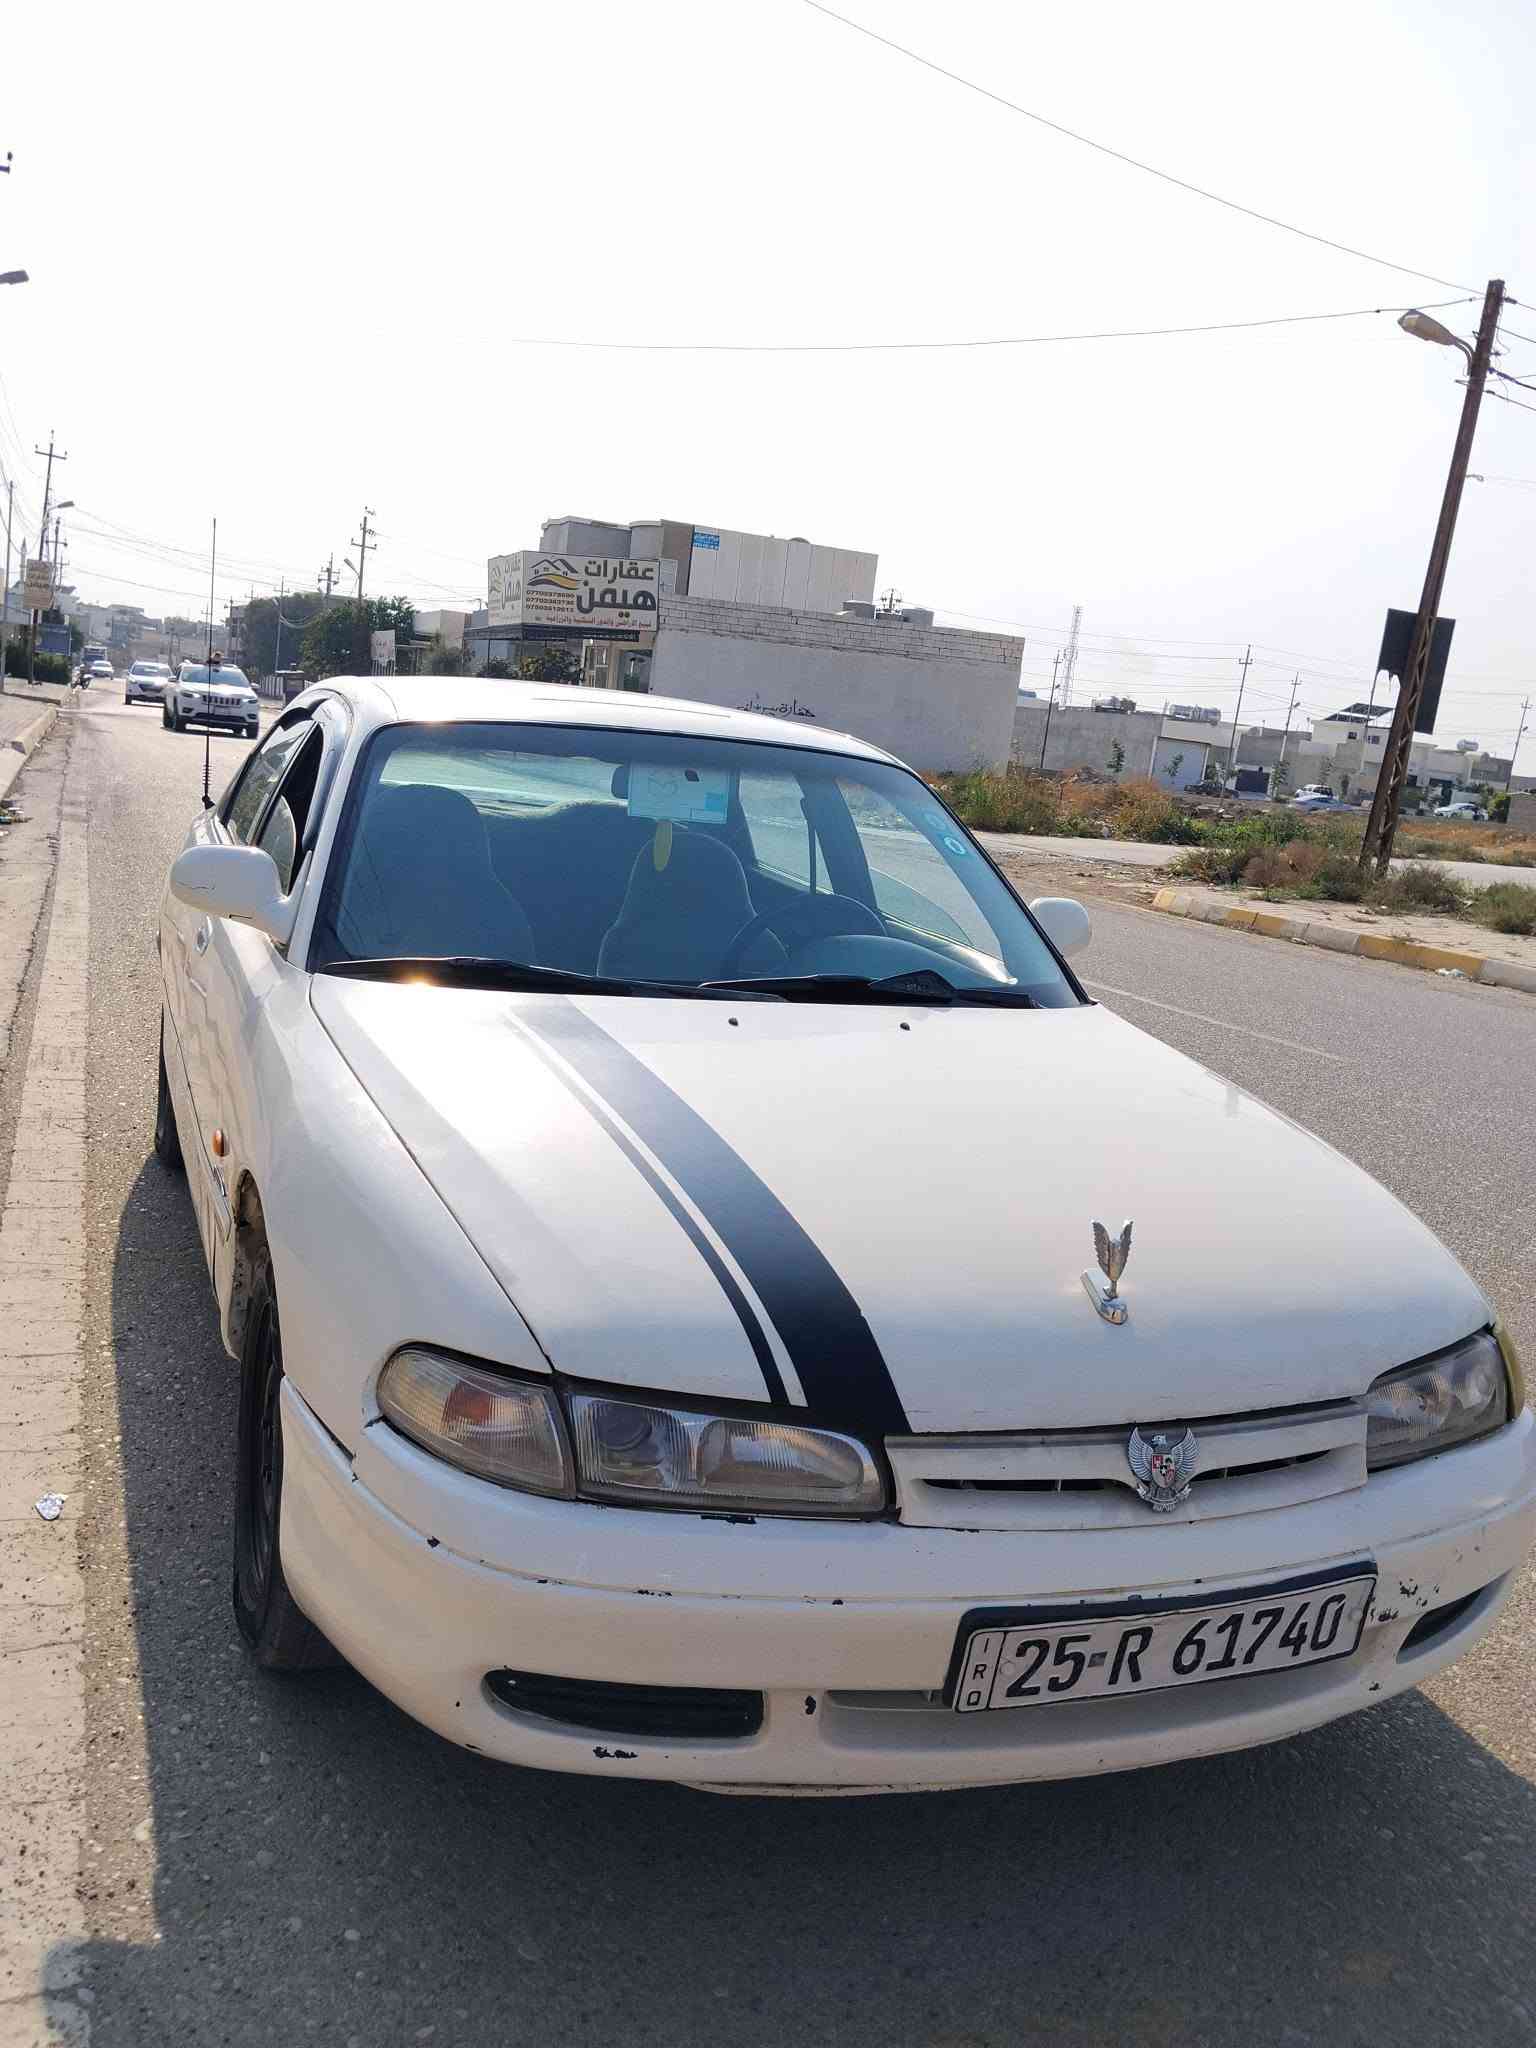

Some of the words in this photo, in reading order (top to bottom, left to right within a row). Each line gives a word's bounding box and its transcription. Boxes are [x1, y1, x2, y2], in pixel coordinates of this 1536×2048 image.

[584, 559, 654, 584] عقارات
[576, 580, 657, 618] هيمن
[1172, 1592, 1347, 1676] 61740
